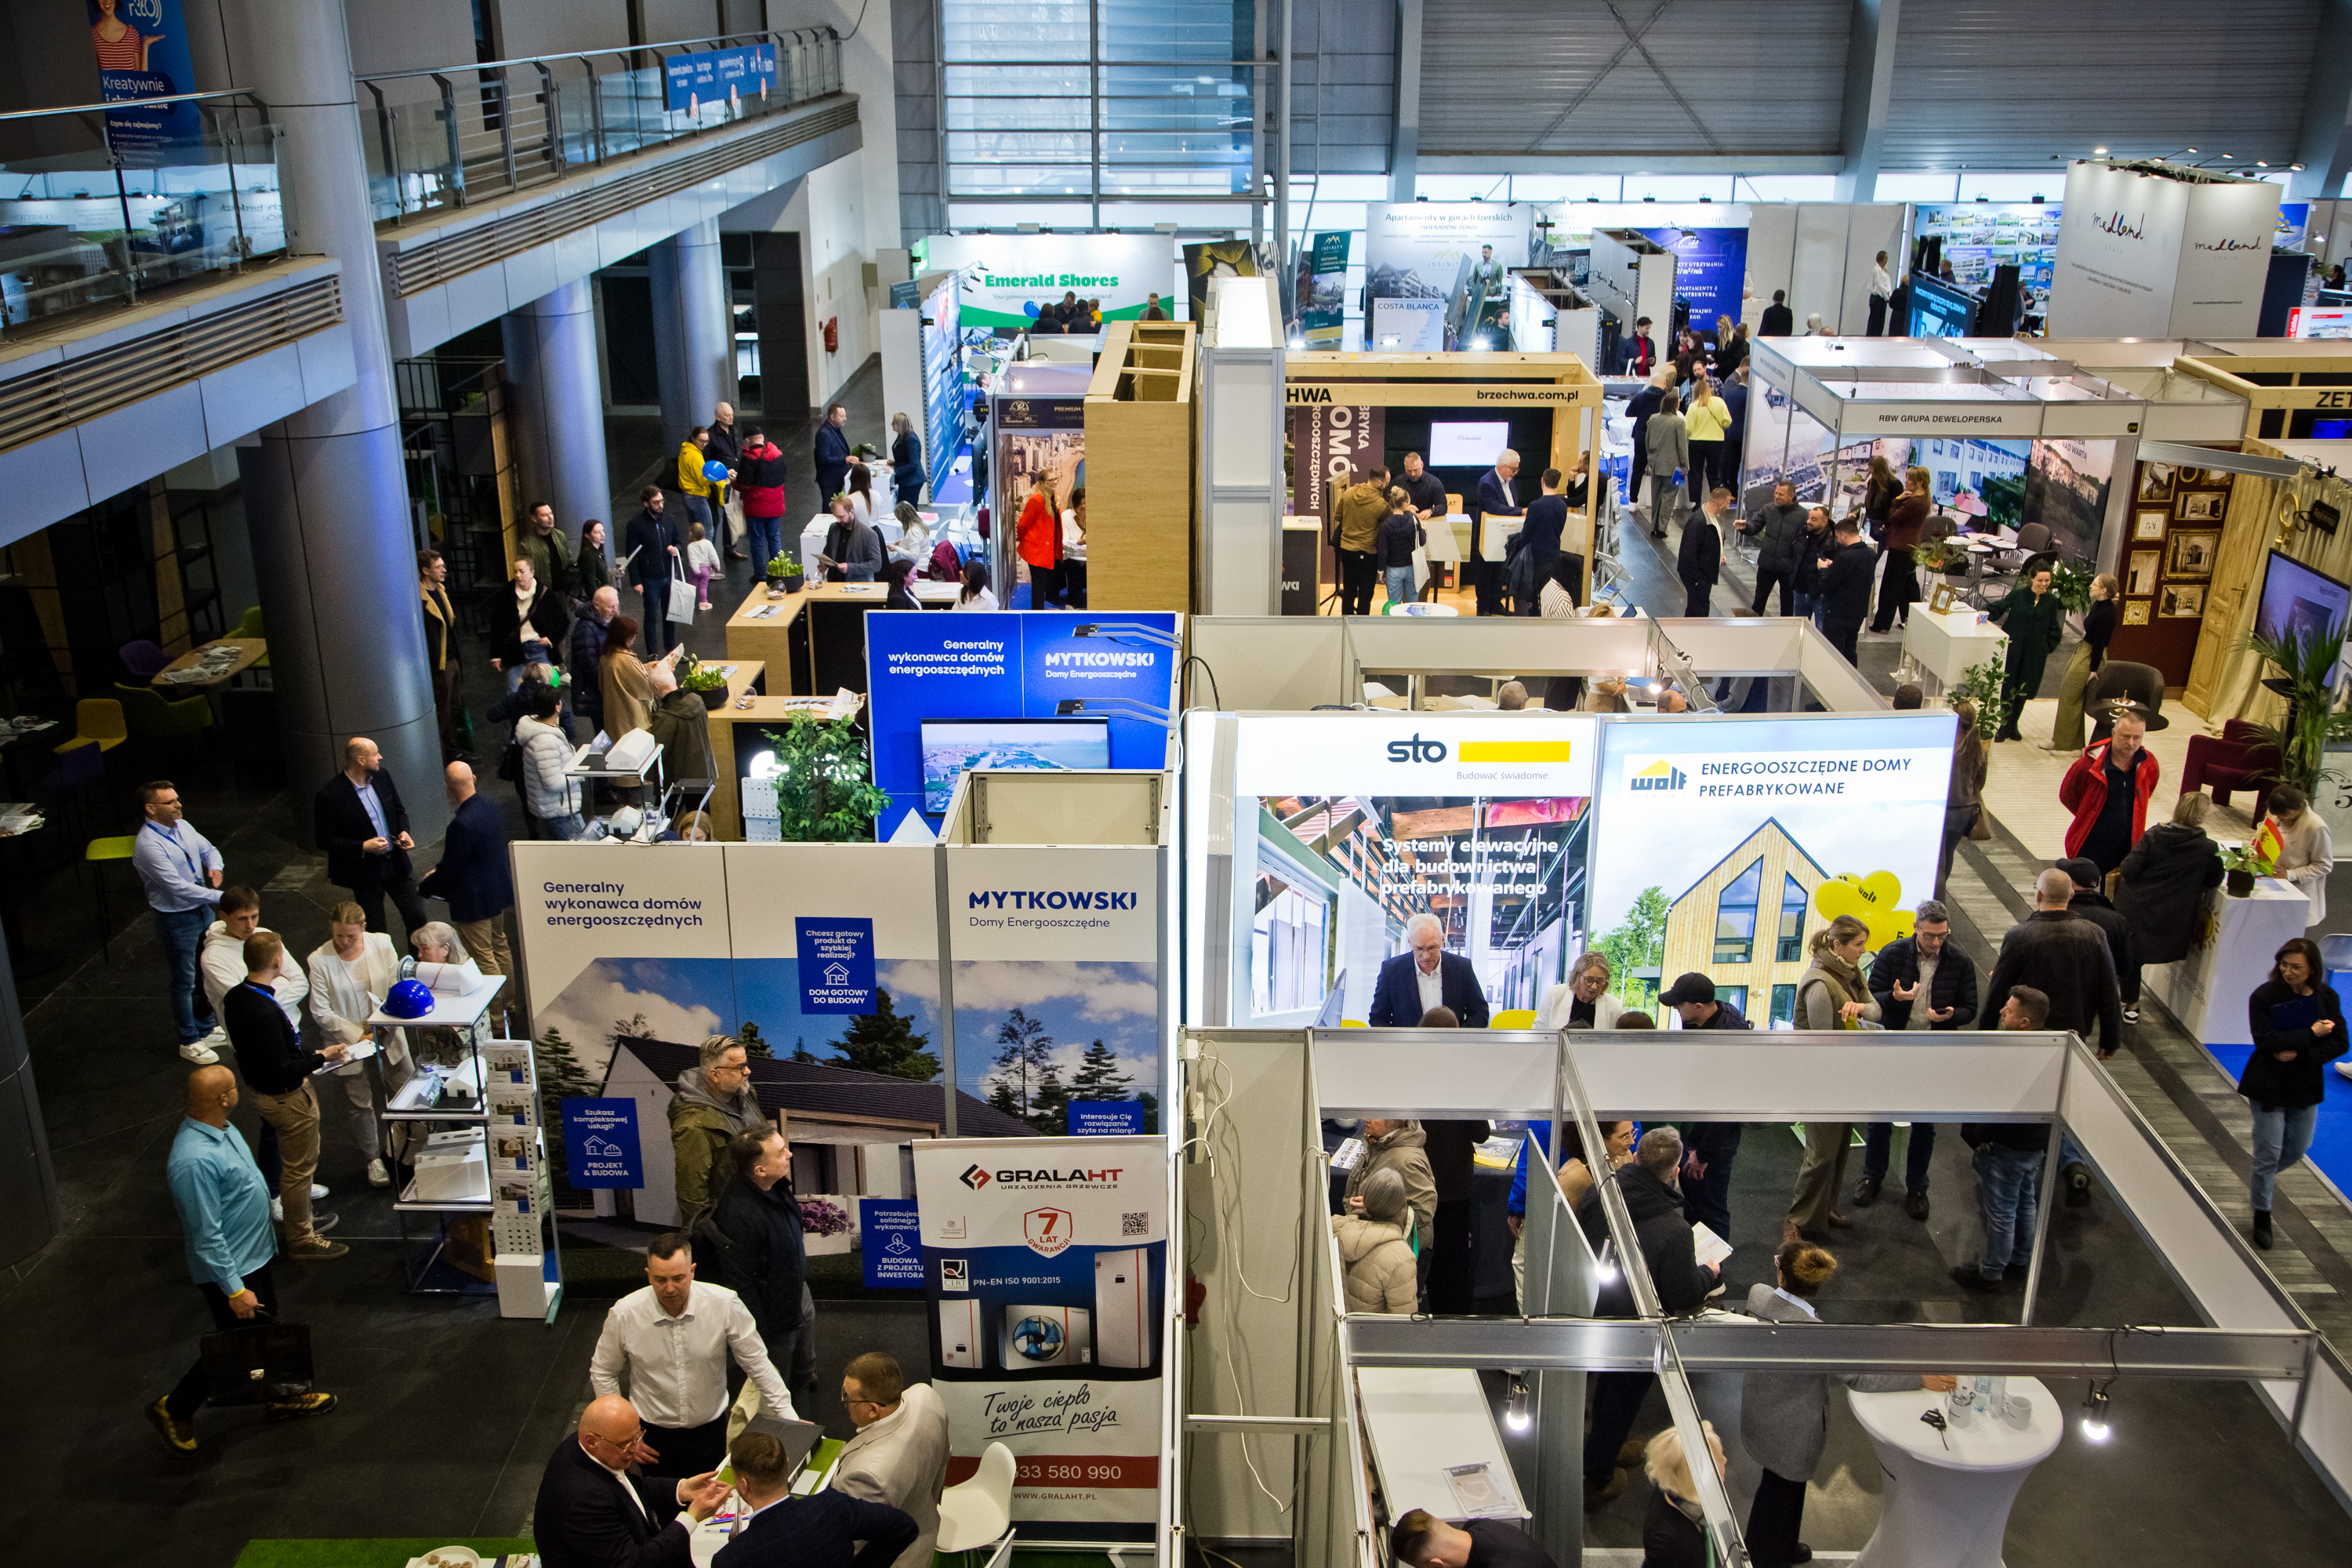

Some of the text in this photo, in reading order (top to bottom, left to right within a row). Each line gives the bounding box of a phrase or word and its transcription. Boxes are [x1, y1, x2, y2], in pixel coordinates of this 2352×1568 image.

[103, 76, 165, 93] Kreatywnie
[1385, 213, 1437, 223] Apartamenty
[1449, 213, 1475, 223] górach
[1477, 213, 1512, 222] Izerskich
[2092, 211, 2145, 241] medland
[2193, 236, 2262, 251] medland
[985, 274, 1119, 287] Emerald Shores
[1286, 388, 1578, 402] HWA brzechwa.com.pl
[1358, 405, 1370, 449] BRYKA
[1328, 406, 1358, 477] OMÓ
[1309, 405, 1321, 510] RGOOSZCZĘDNYCH
[943, 640, 1004, 652] Generalny
[888, 652, 1004, 663] wykonawca domów
[1046, 652, 1154, 666] MYTKOWSKI
[889, 664, 1004, 677] energooszczędnych
[1046, 670, 1137, 680] Domy Energooszczędne
[1387, 732, 1447, 763] sto
[1701, 758, 1911, 775] ENERGOOSZCZĘDNE DOMY
[1457, 770, 1551, 780] Budować świadomie.
[1631, 766, 1687, 790] wolf
[1700, 782, 1845, 797] PREFABRYKOWANE
[1382, 838, 1559, 856] Systemy elewacyjne
[1382, 858, 1537, 873] dla budownictwa
[543, 881, 625, 896] Generalny
[1381, 880, 1548, 898] prefabrykowanego
[544, 897, 702, 912] wykonawca domów
[969, 891, 1137, 910] MYTKOWSKI
[546, 914, 702, 929] energooszczędnych
[969, 916, 1110, 930] Domy Energooszczędne
[814, 937, 844, 946] produkt
[835, 931, 864, 939] gotowy
[820, 944, 851, 953] szybkiej
[996, 1168, 1123, 1182] GRALAHT
[1038, 1213, 1058, 1235] 7
[1027, 1237, 1071, 1253] GWARANCJI
[973, 1278, 1002, 1287] PN-EN
[984, 1383, 1091, 1421] Twoje ciepło
[990, 1406, 1117, 1434] to nasza pasja
[1048, 1465, 1081, 1479] 580
[1087, 1465, 1121, 1479] 990
